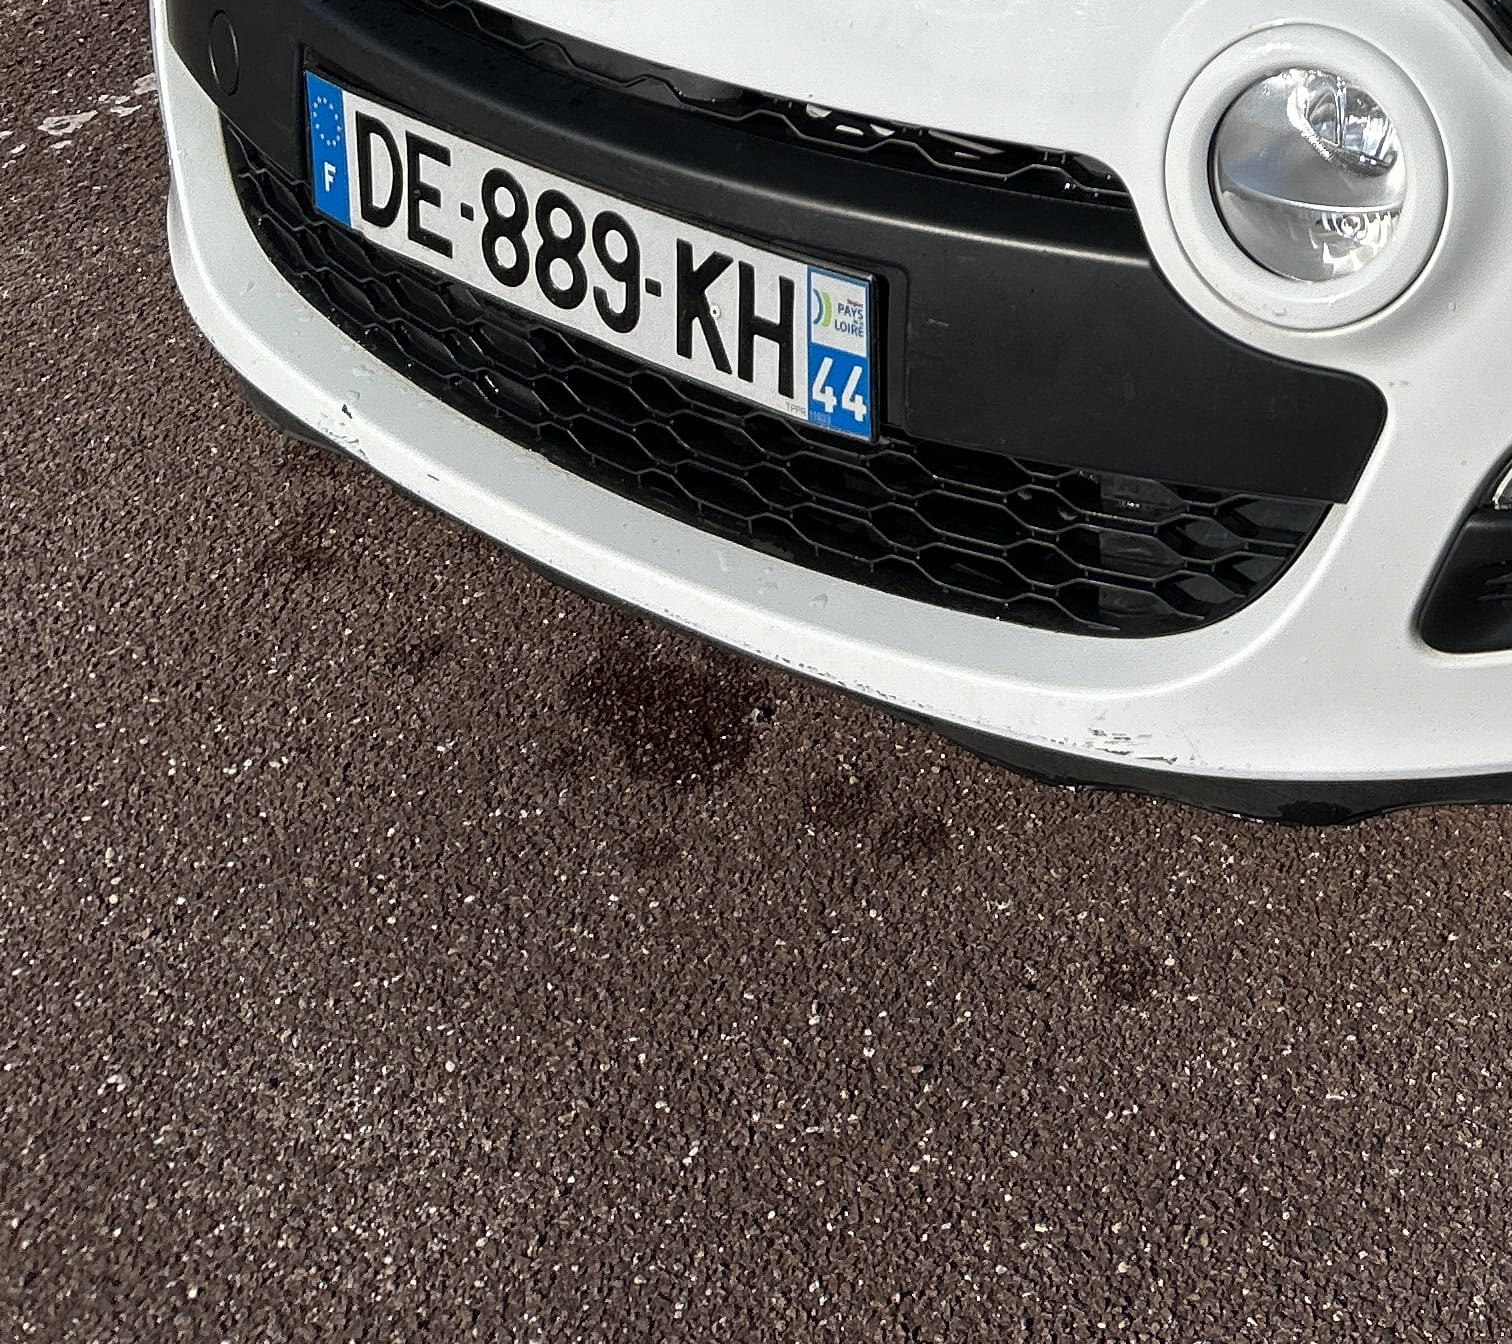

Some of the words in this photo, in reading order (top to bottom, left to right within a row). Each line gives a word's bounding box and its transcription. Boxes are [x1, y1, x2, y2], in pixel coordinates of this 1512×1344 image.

[324, 161, 336, 193] F
[355, 110, 795, 399] DE-889-KH
[837, 302, 864, 320] PAYS
[834, 318, 864, 338] LOIRE
[812, 357, 867, 422] 44
